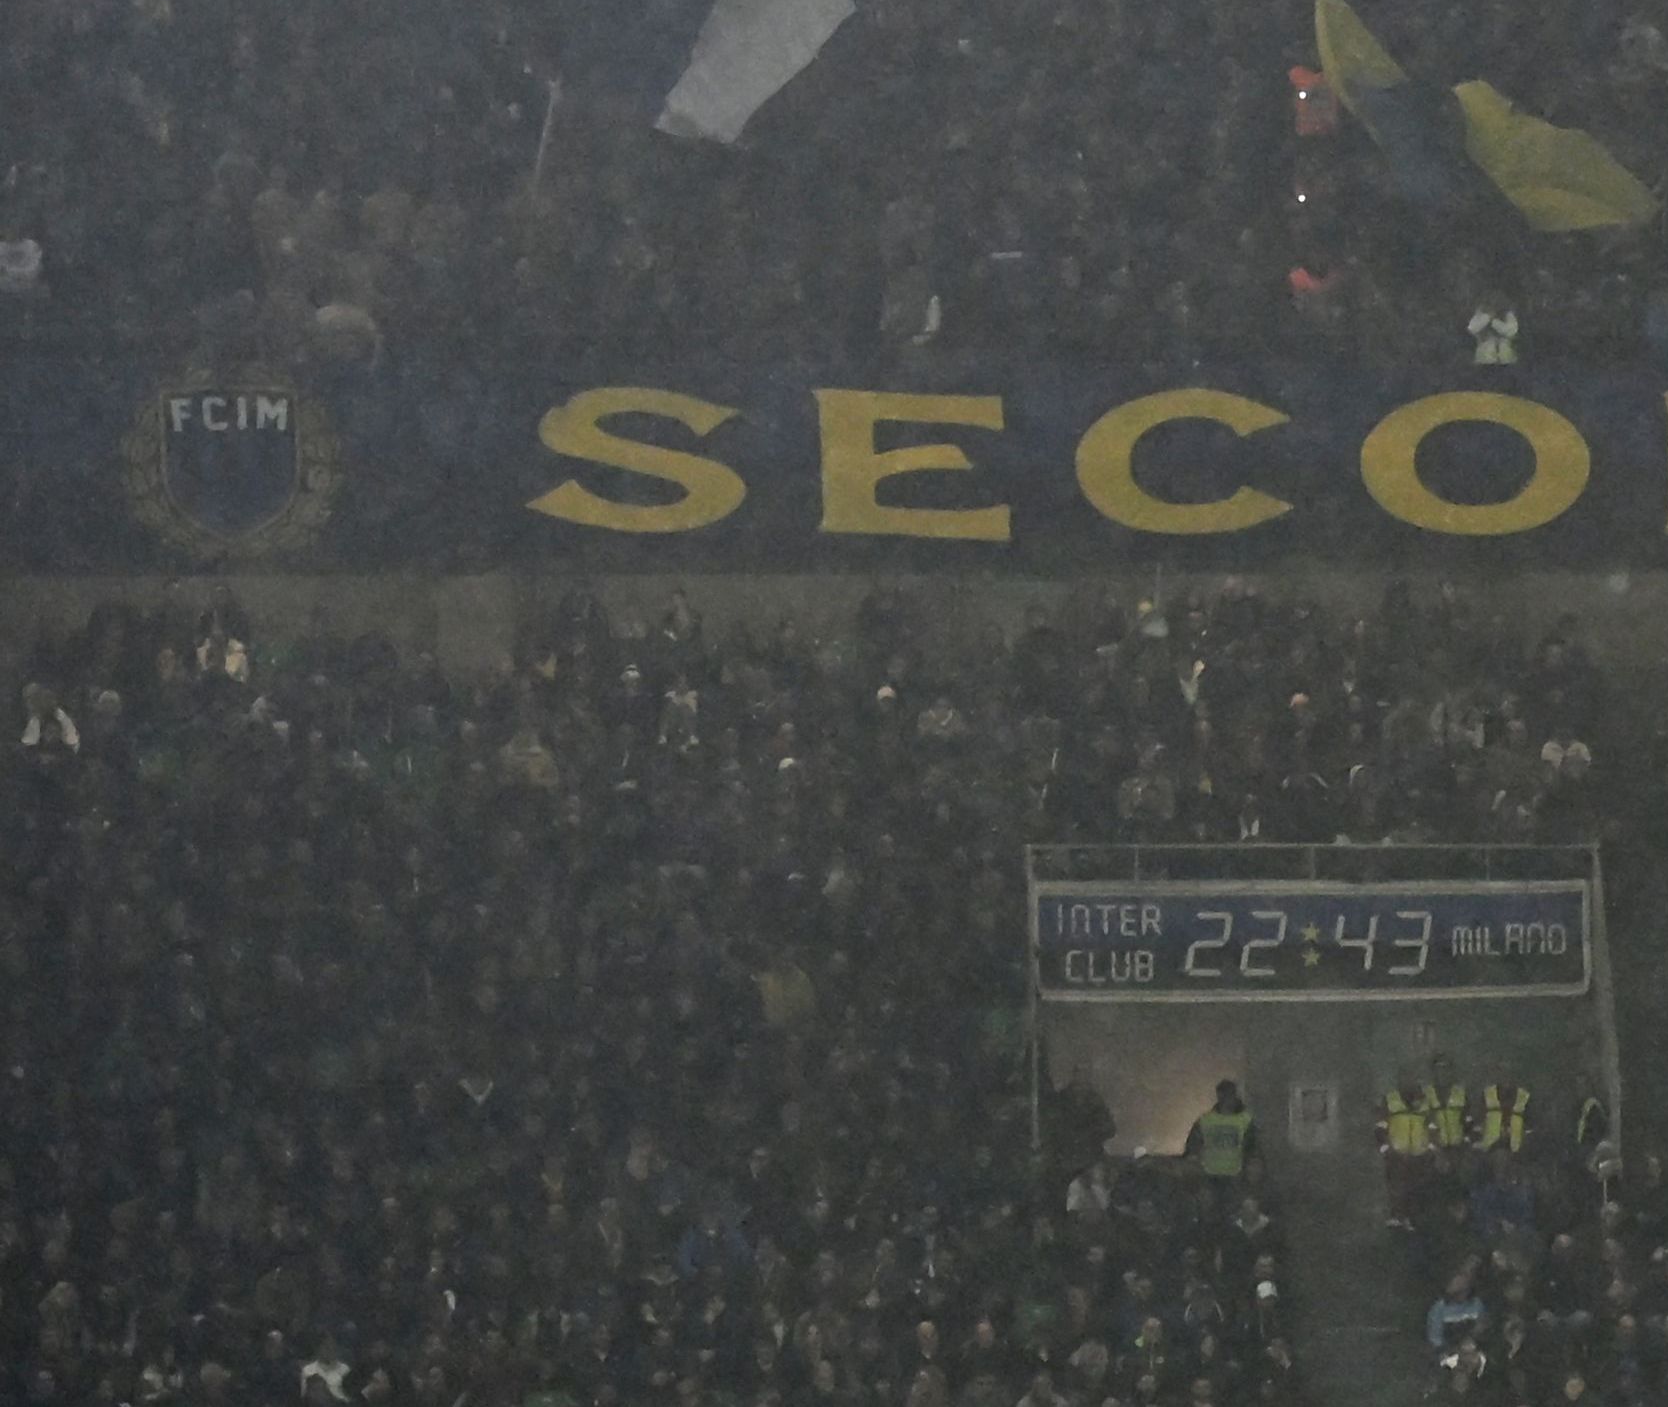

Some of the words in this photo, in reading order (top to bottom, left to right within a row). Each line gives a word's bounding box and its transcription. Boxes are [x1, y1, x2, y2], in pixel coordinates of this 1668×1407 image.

[170, 395, 290, 433] FCIM
[1057, 904, 1161, 936] INTER
[1452, 923, 1566, 956] MILANO
[1066, 950, 1154, 982] CLUB
